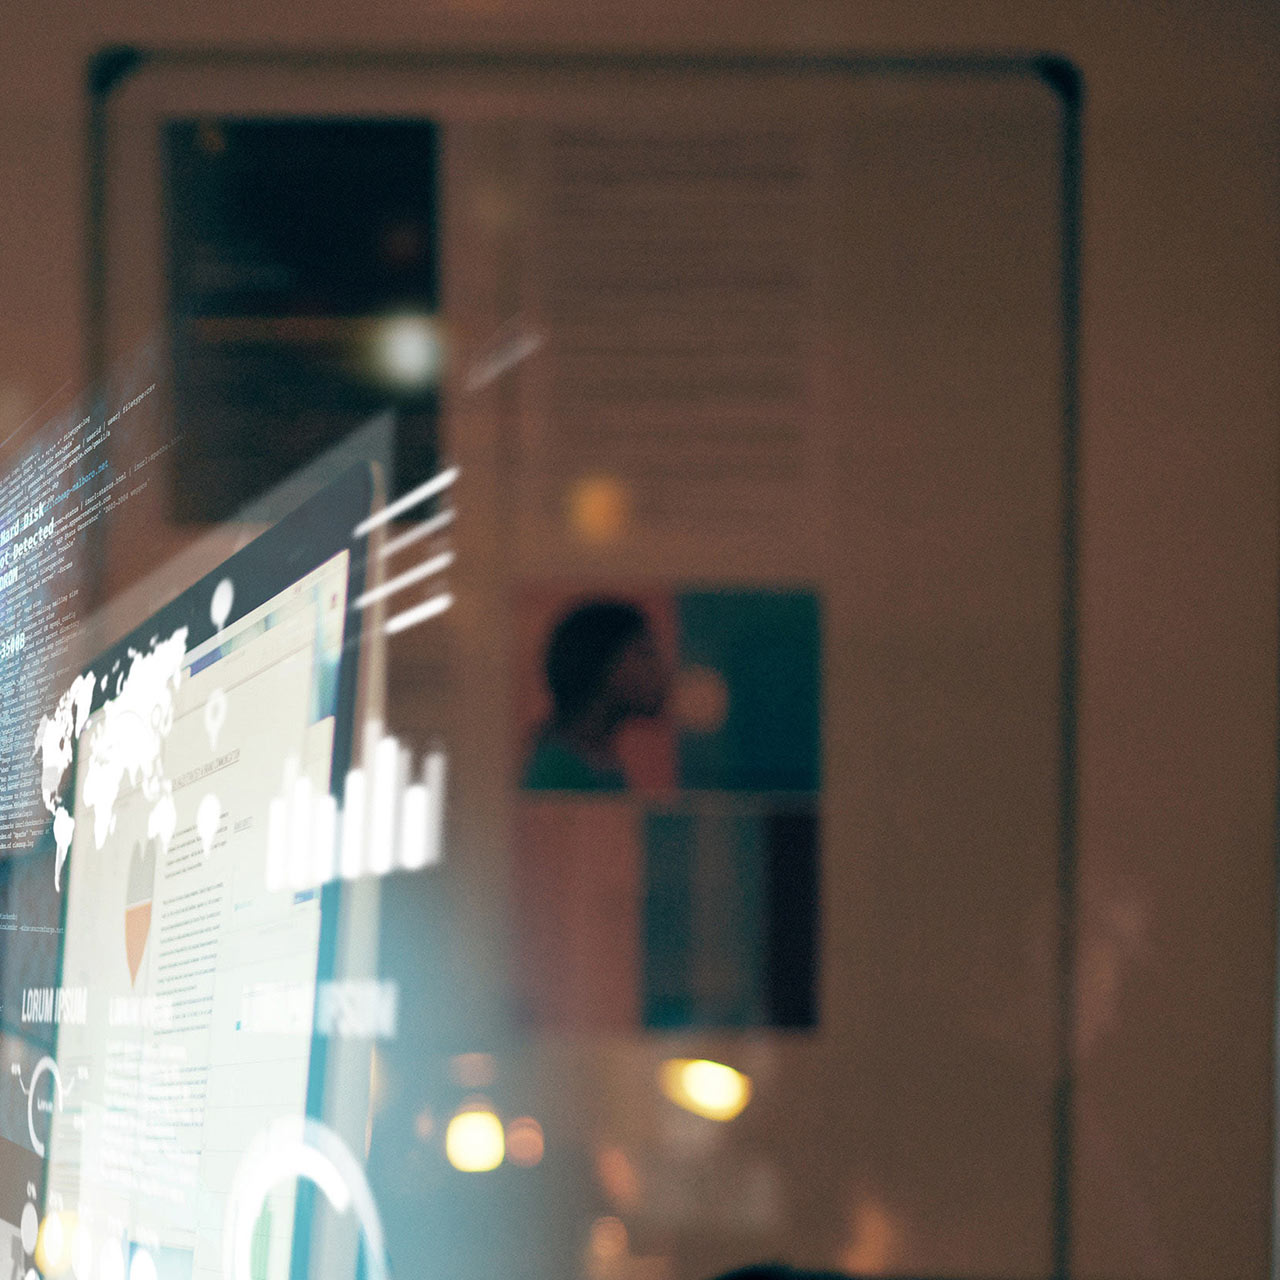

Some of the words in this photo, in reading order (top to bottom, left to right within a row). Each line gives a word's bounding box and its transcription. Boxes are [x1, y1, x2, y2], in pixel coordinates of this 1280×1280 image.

[23, 501, 45, 529] Disk
[13, 517, 55, 559] Detected
[21, 986, 54, 1023] LORUM
[54, 986, 88, 1024] IPSUM
